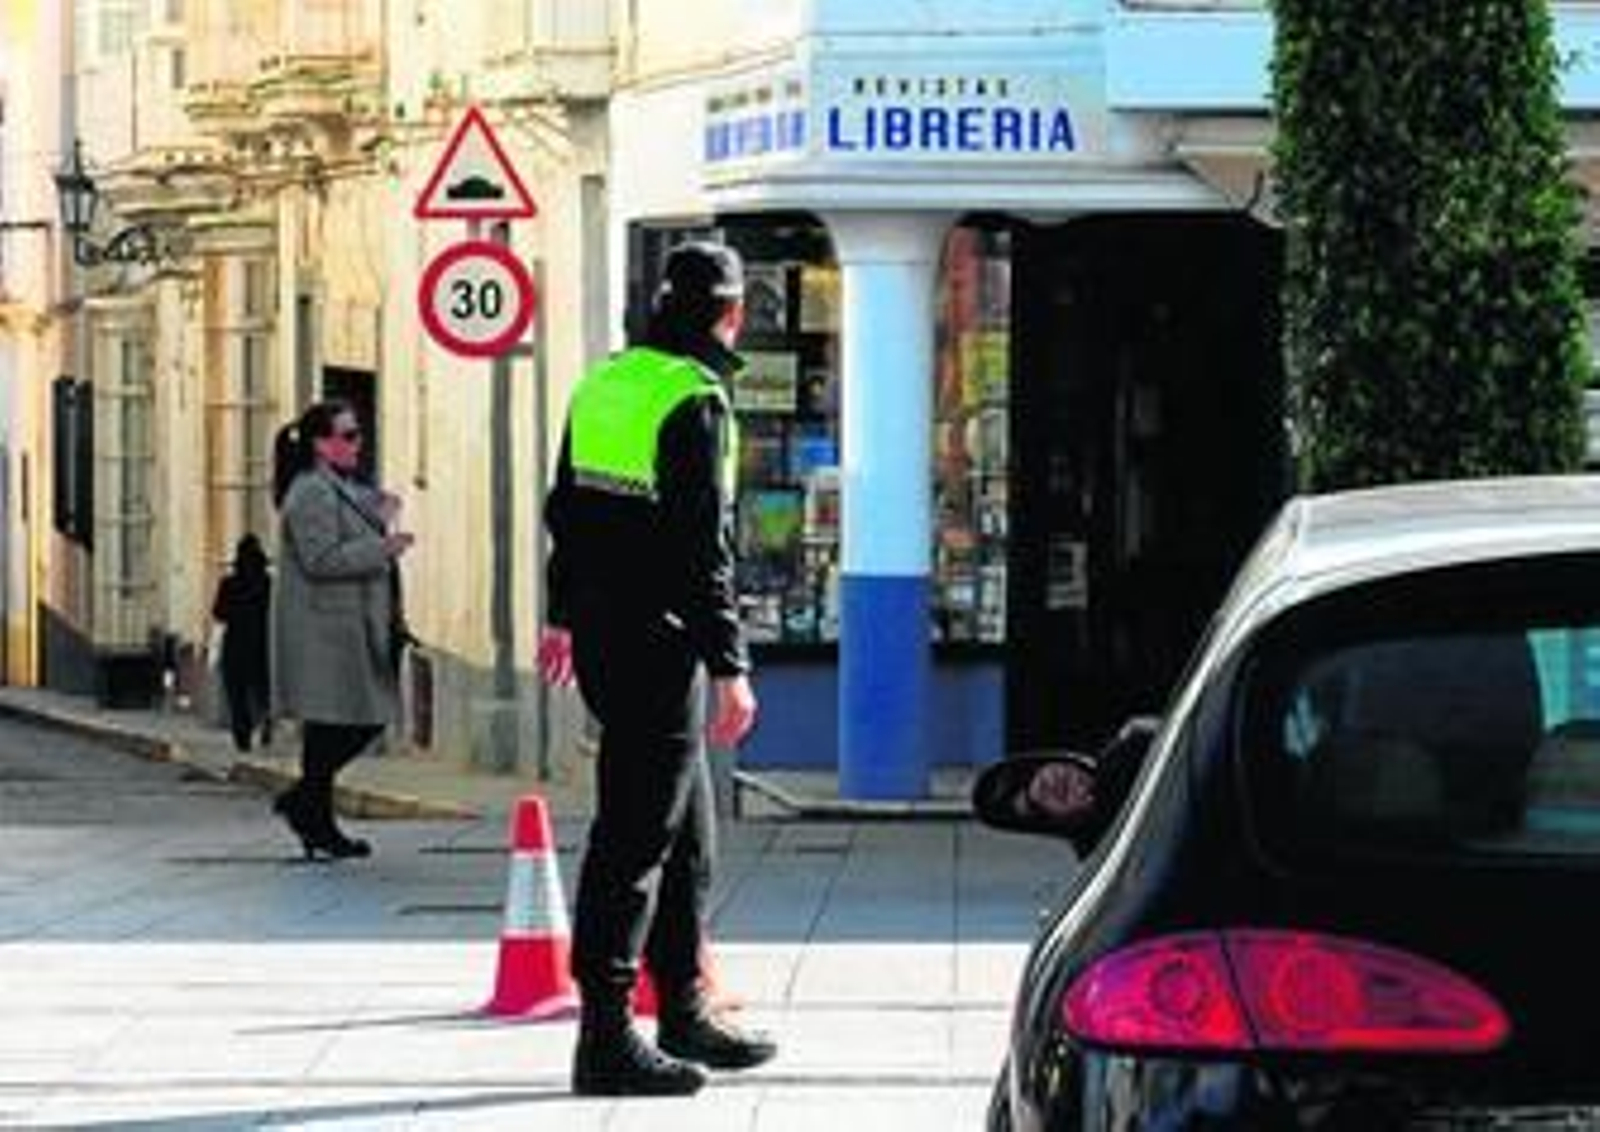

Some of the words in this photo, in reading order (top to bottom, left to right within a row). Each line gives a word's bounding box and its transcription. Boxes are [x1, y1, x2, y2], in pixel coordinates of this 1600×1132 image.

[853, 78, 1009, 97] REVISTAS
[829, 107, 1075, 151] LIBRERIA
[451, 279, 502, 319] 30
